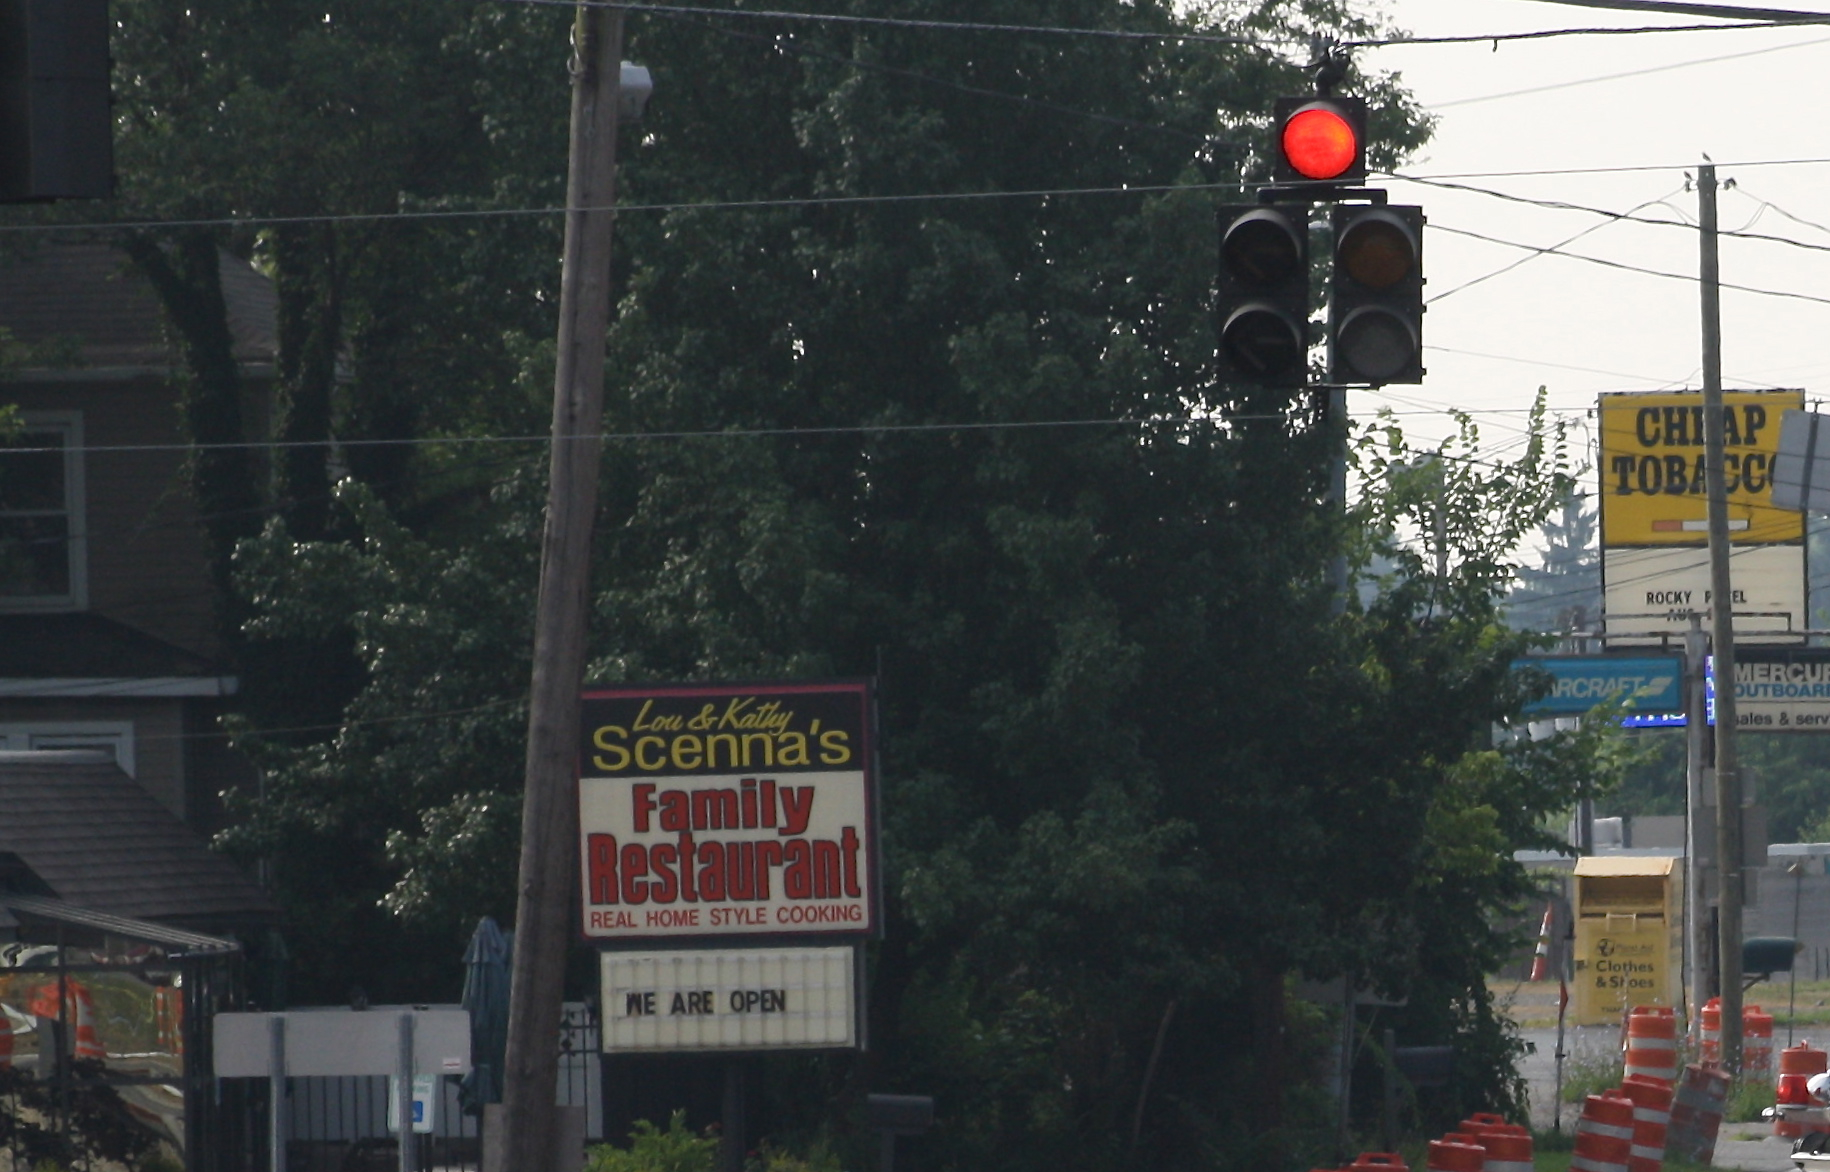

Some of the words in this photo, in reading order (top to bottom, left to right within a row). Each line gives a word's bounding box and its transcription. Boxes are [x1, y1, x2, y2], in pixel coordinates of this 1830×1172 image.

[1645, 590, 1692, 605] ROCKY
[1704, 589, 1747, 604] PEL
[633, 700, 683, 732] Lou
[688, 704, 718, 729] &
[718, 697, 793, 735] Kathy
[1780, 711, 1789, 726] &
[592, 719, 851, 772] Scenna's
[631, 778, 815, 836] Family
[587, 826, 861, 905] Restaurant
[590, 911, 638, 929] REAL
[646, 909, 699, 928] HOME
[710, 907, 767, 926] STYLE
[776, 904, 862, 925] COOKING
[1596, 960, 1654, 972] Clothes
[1596, 976, 1606, 988] &
[625, 991, 656, 1016] WE
[670, 990, 713, 1015] ARE
[729, 989, 786, 1013] OPEN
